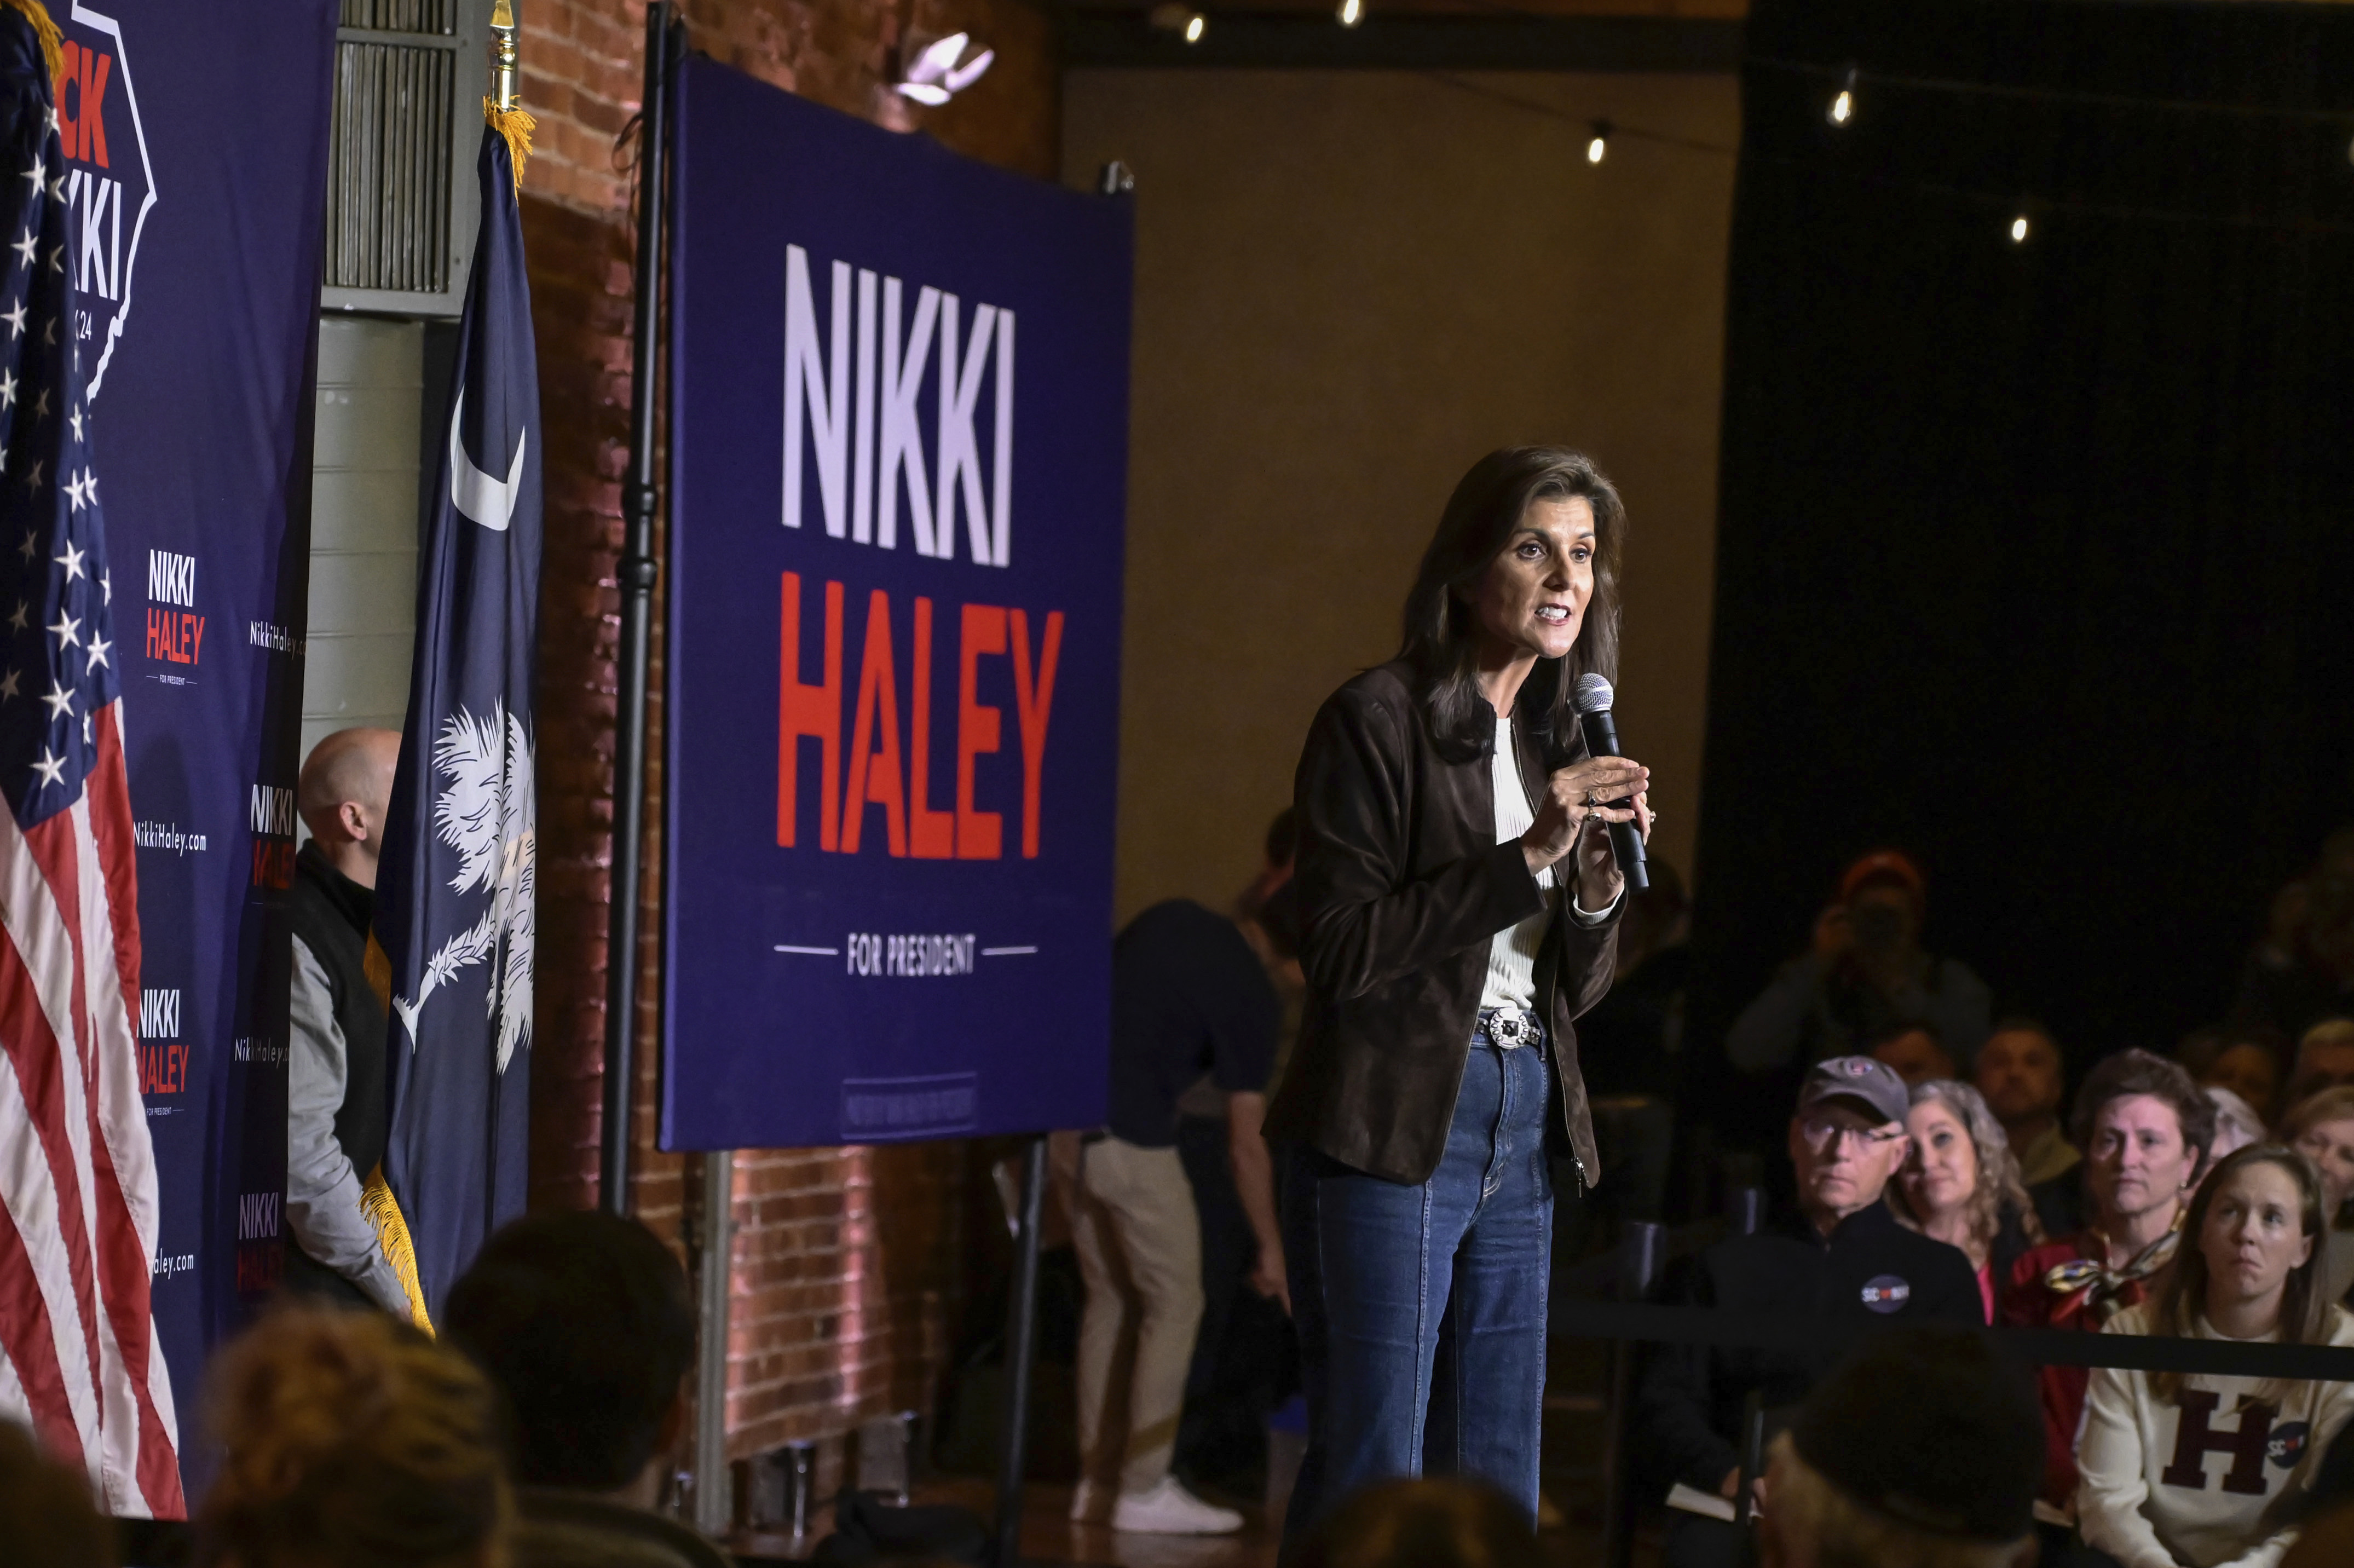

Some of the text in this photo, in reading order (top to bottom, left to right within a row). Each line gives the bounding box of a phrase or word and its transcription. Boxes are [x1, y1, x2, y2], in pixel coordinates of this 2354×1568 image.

[55, 40, 111, 169] CK
[781, 243, 1015, 568] NIKKI
[148, 549, 195, 607] NIKKI
[146, 608, 205, 665] HALEY
[167, 676, 185, 685] PRESIDENT
[776, 570, 1065, 860] HALEY
[250, 783, 293, 836] NIKKI
[134, 821, 206, 857] NikkiHaley.com
[847, 932, 976, 977] FOR PRESIDENT
[136, 989, 180, 1038] NIKKI
[154, 1106, 171, 1116] PRESIDENT
[239, 1192, 279, 1240] NIKKI
[154, 1248, 194, 1279] aley.com
[2162, 1389, 2280, 1495] H
